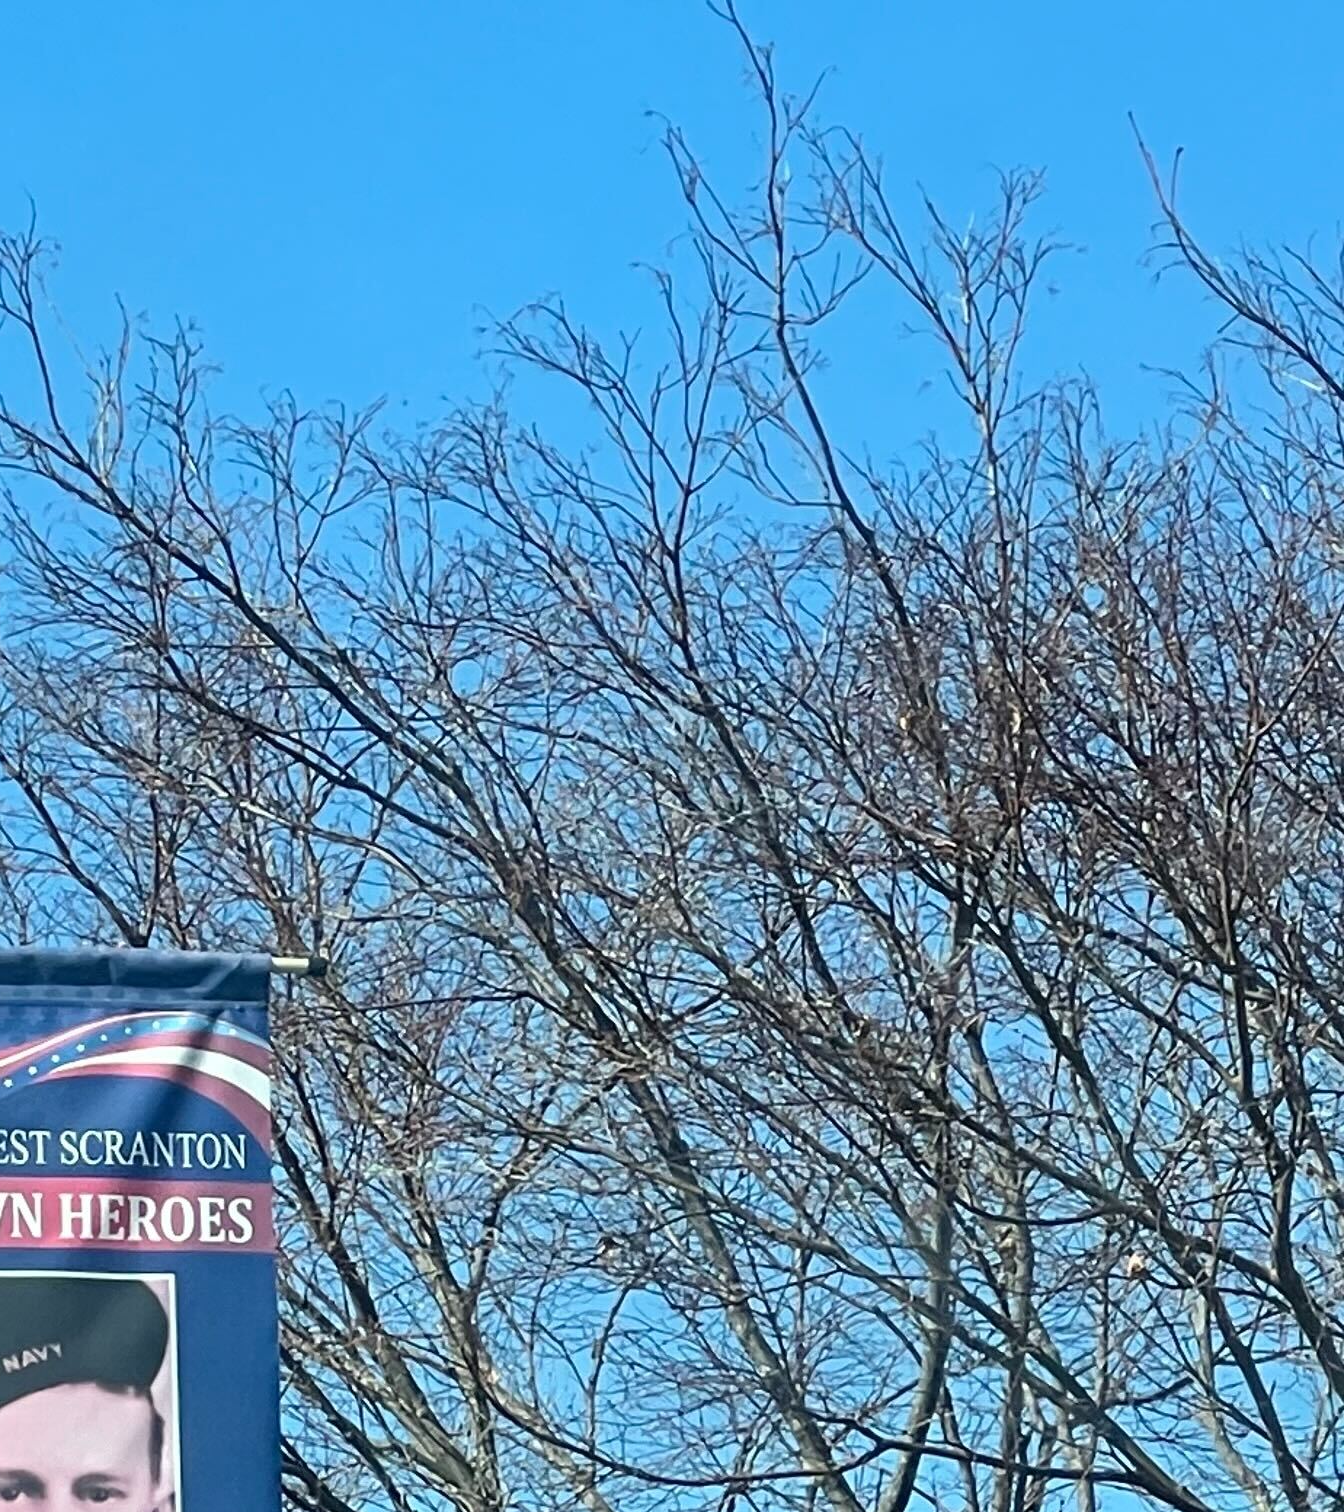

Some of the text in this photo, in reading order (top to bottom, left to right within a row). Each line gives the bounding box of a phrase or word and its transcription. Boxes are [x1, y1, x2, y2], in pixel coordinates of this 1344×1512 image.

[59, 1130, 247, 1169] SCRANTON
[57, 1193, 254, 1243] HEROES
[2, 1342, 62, 1374] NAVY
